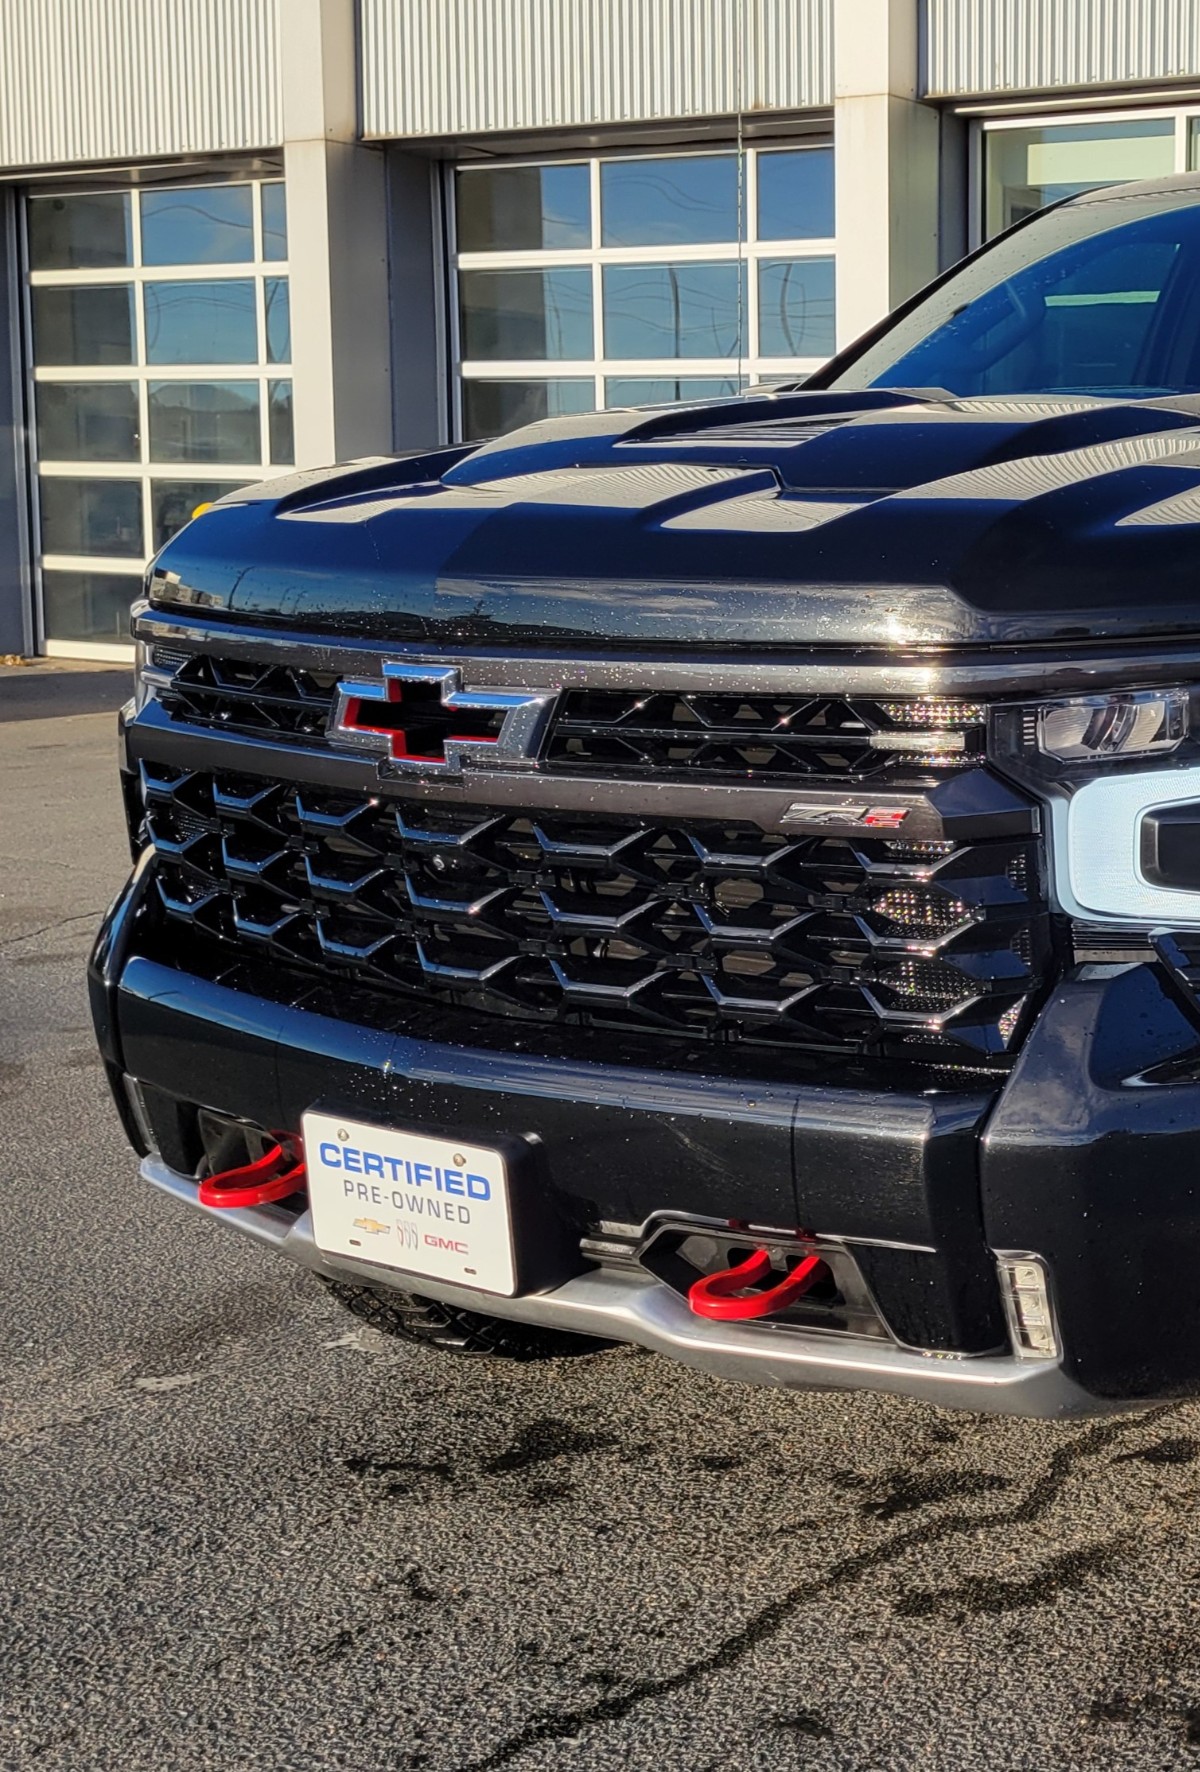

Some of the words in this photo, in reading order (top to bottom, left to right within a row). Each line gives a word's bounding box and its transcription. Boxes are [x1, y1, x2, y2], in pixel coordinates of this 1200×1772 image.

[780, 803, 912, 828] ZR2
[319, 1142, 491, 1201] CERTIFIED
[343, 1179, 471, 1224] PRE-OWNED
[424, 1234, 469, 1255] GMC
